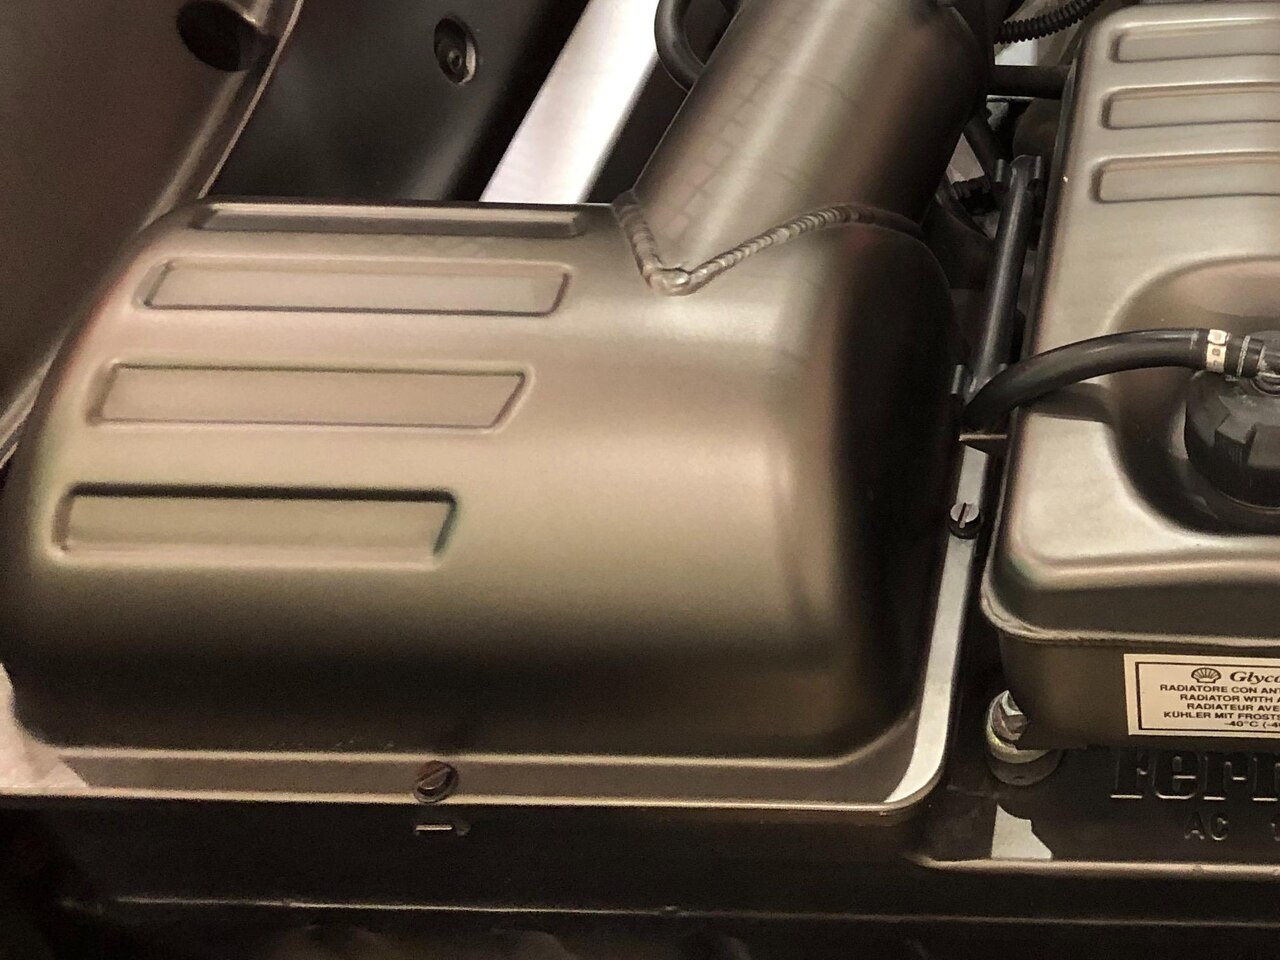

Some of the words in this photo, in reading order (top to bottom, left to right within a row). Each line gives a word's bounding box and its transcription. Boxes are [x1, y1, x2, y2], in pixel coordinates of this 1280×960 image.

[1160, 684, 1228, 693] RADIATORE
[1231, 686, 1257, 694] CON
[1180, 693, 1240, 702] RADIATOR
[1243, 695, 1274, 704] WITH
[1187, 702, 1254, 711] RADIATEUR
[1163, 710, 1212, 719] KÜHLER
